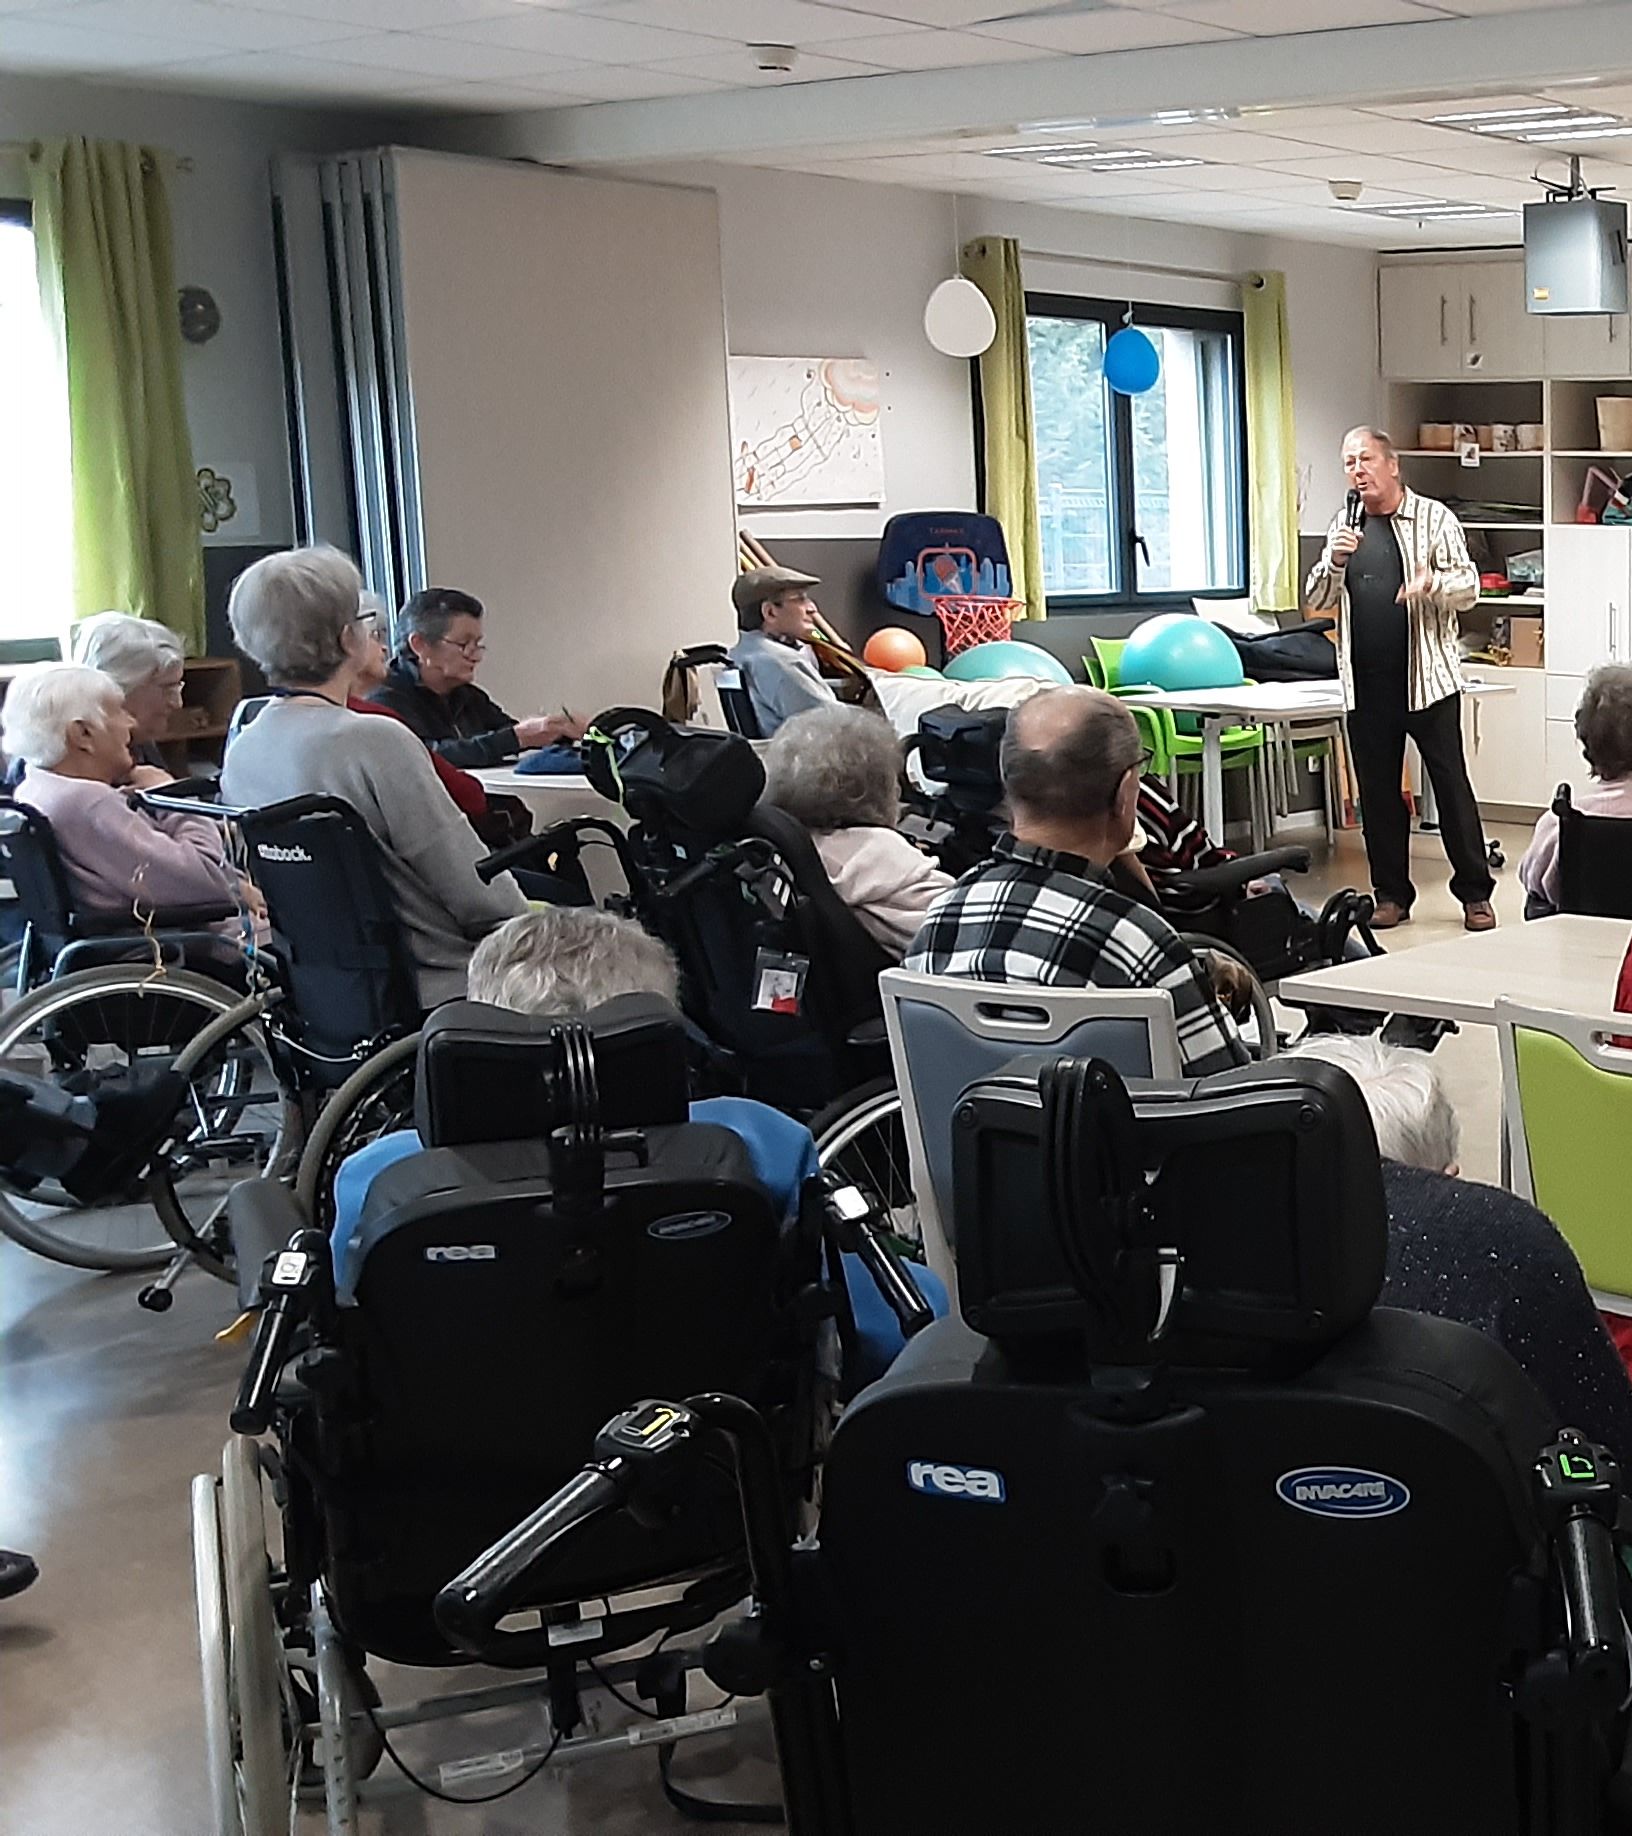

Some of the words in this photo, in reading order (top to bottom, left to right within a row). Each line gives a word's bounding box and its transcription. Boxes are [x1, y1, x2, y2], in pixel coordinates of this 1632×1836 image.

[426, 1244, 496, 1261] rea
[910, 1462, 1001, 1499] rea
[1295, 1481, 1387, 1501] INVACARE
